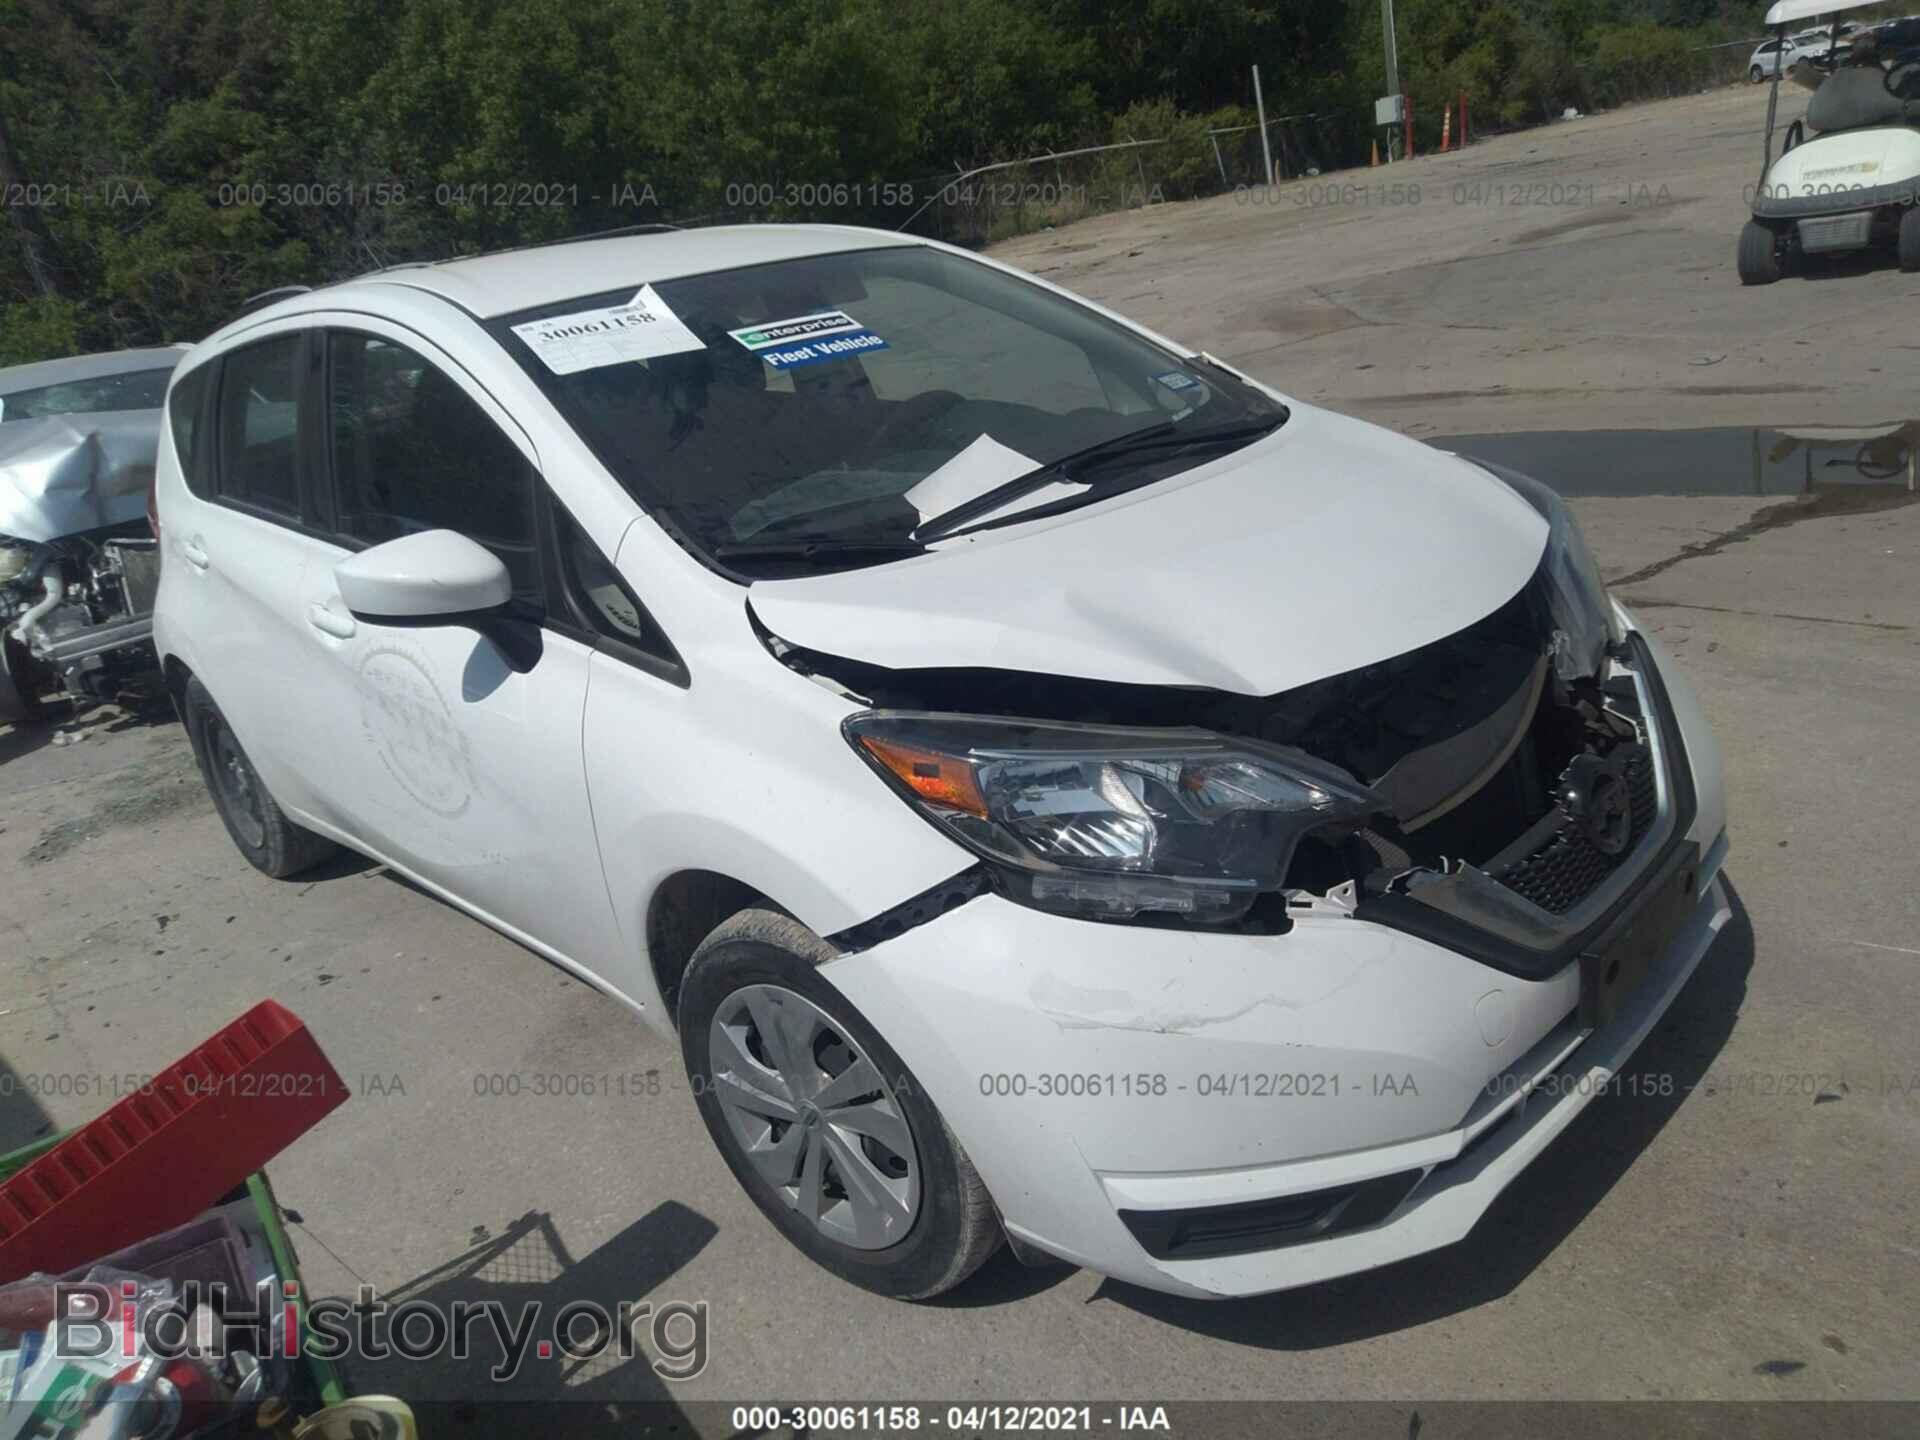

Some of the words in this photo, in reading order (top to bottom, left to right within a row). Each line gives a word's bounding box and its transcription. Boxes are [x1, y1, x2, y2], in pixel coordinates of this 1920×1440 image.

[538, 312, 657, 343] 30061158
[748, 316, 850, 344] enterprise
[763, 347, 819, 366] Fleet
[813, 334, 884, 355] Vehicle
